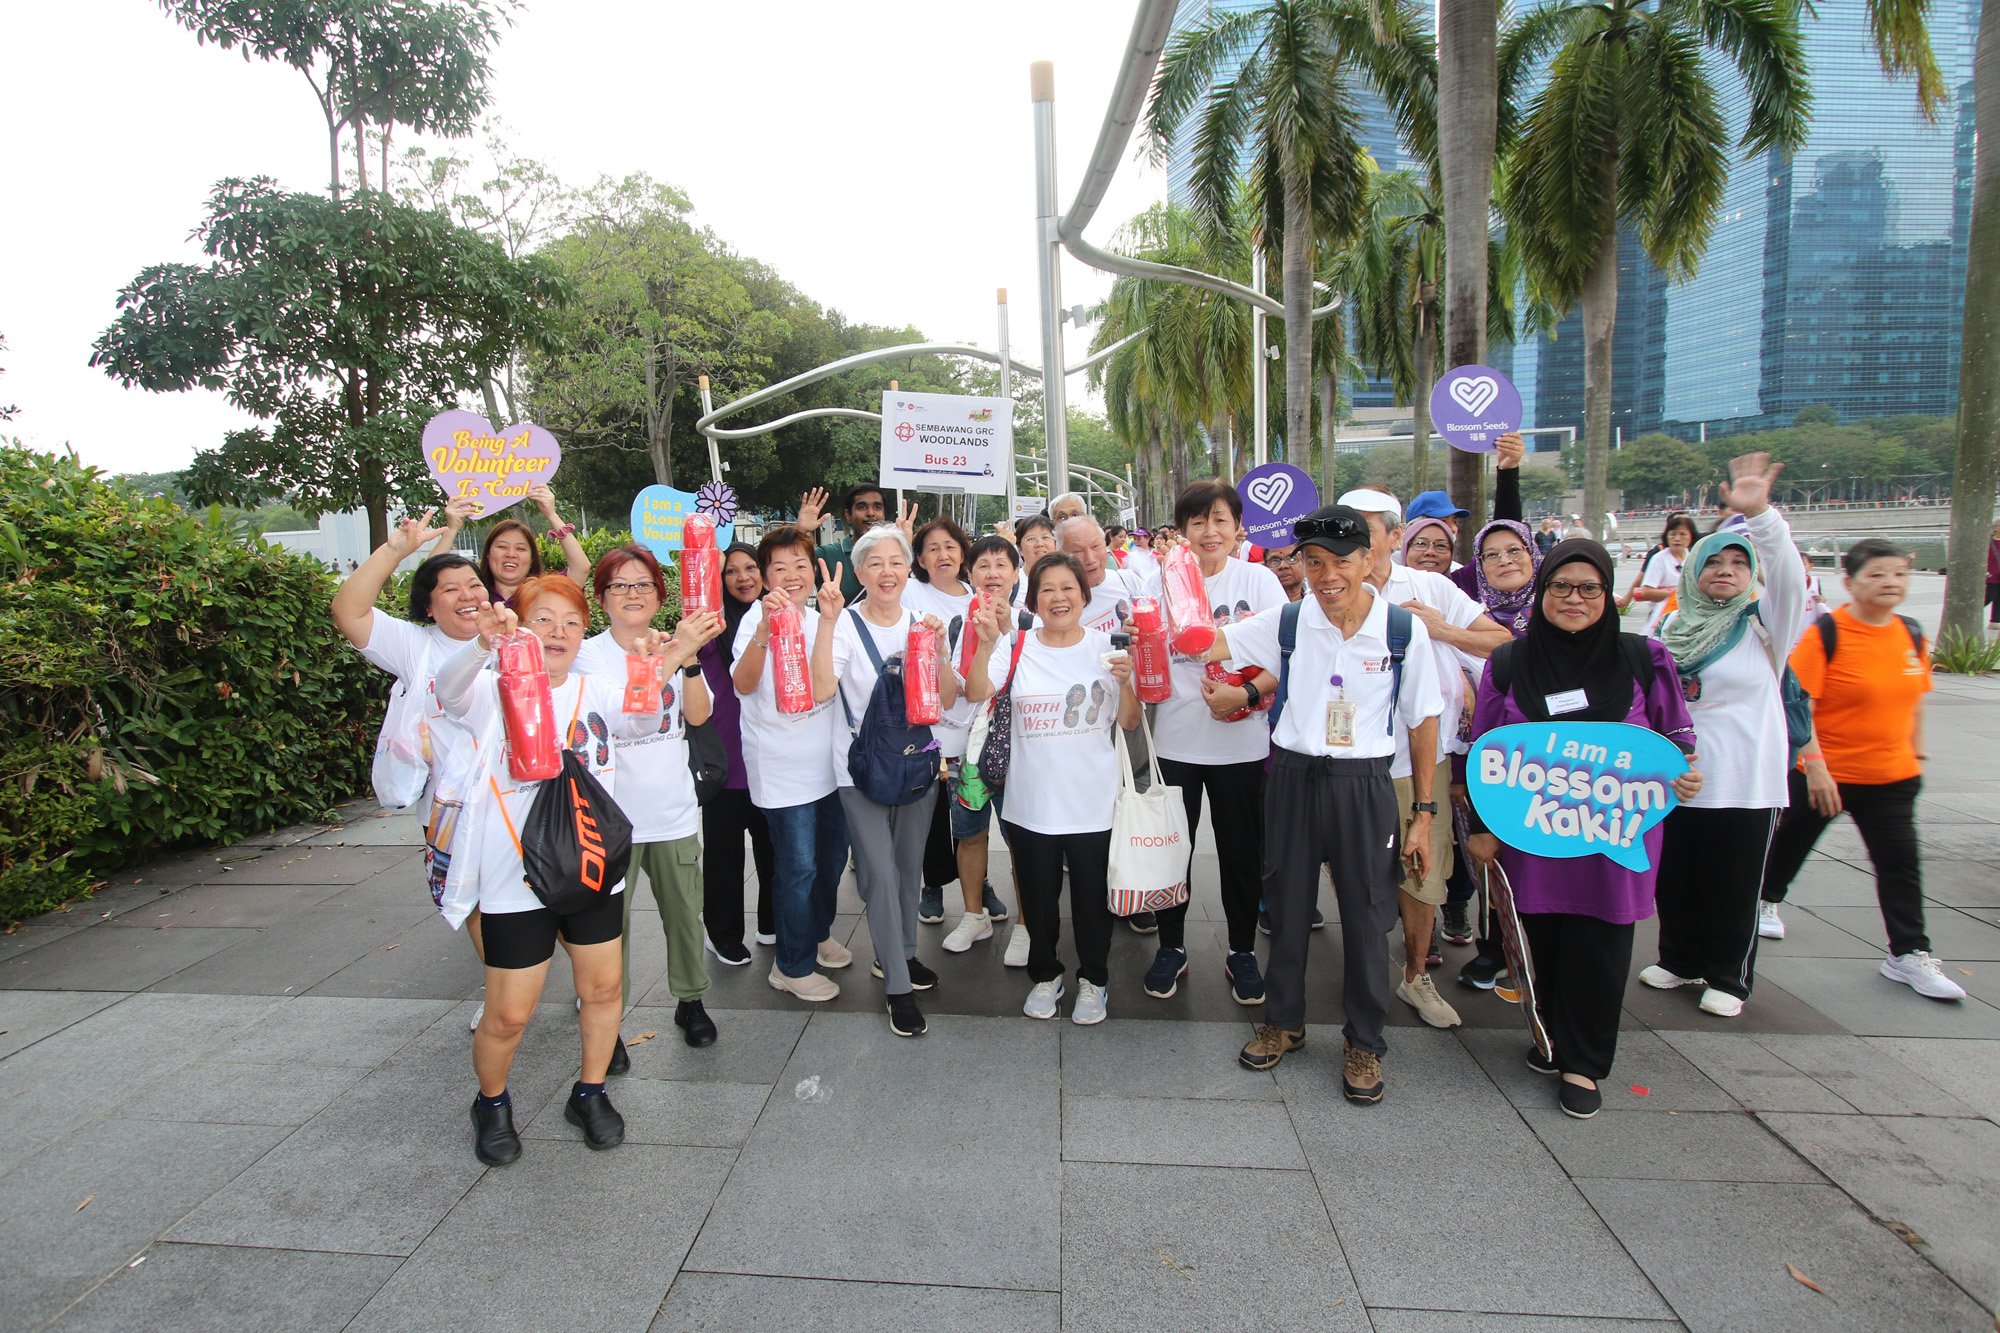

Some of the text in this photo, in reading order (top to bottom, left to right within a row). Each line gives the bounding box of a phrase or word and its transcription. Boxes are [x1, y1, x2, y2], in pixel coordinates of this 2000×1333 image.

[915, 424, 994, 436] SEMBAWANG GRC
[1446, 421, 1509, 432] Blossom Seeds
[452, 429, 531, 457] Being A
[920, 434, 989, 447] WOODLANDS
[431, 446, 551, 478] Volunteer
[924, 454, 967, 466] Bus 23
[456, 478, 532, 497] Is Cool
[644, 495, 682, 512] I am a
[1248, 520, 1282, 534] Blossom
[1016, 700, 1060, 715] NORTH
[1023, 716, 1059, 731] WEST
[1546, 732, 1632, 770] I am a
[1480, 749, 1666, 811] Blossom
[1523, 794, 1643, 848] Kaki!
